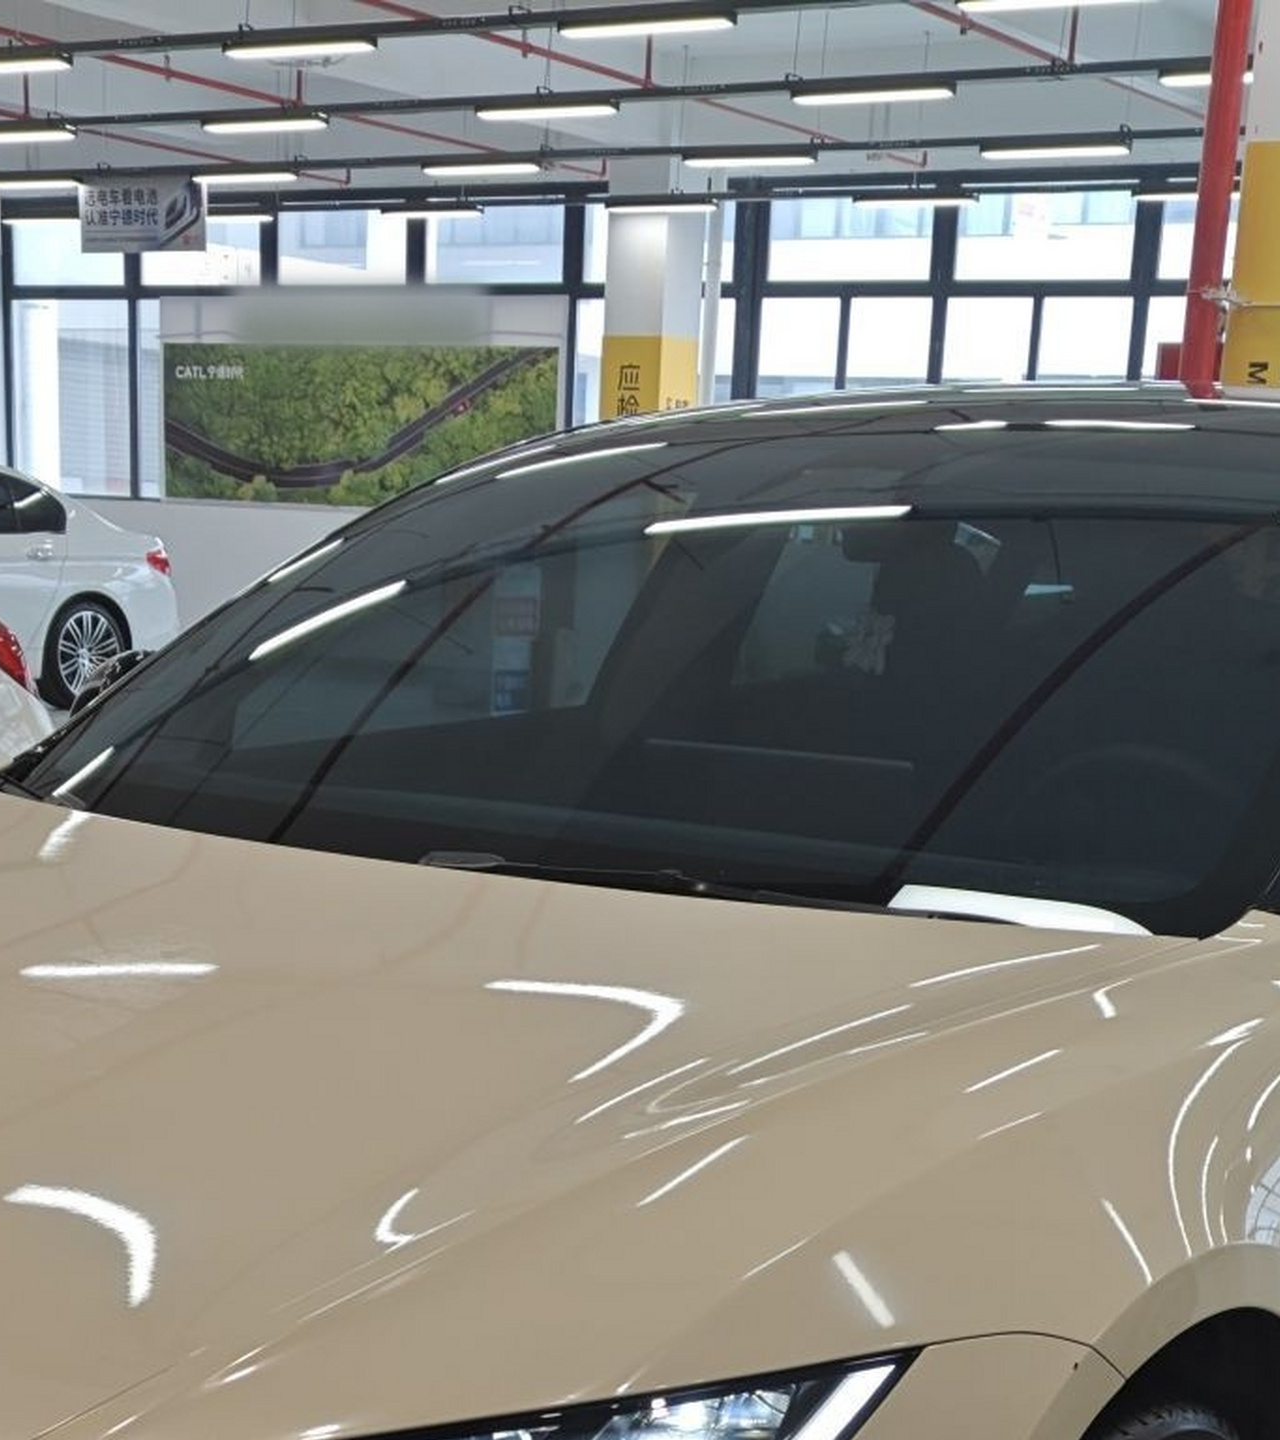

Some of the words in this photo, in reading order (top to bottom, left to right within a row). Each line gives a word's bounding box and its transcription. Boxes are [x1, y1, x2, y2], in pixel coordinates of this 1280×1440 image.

[85, 188, 158, 206] 选电车看电池
[85, 208, 159, 226] 认准宁德时代
